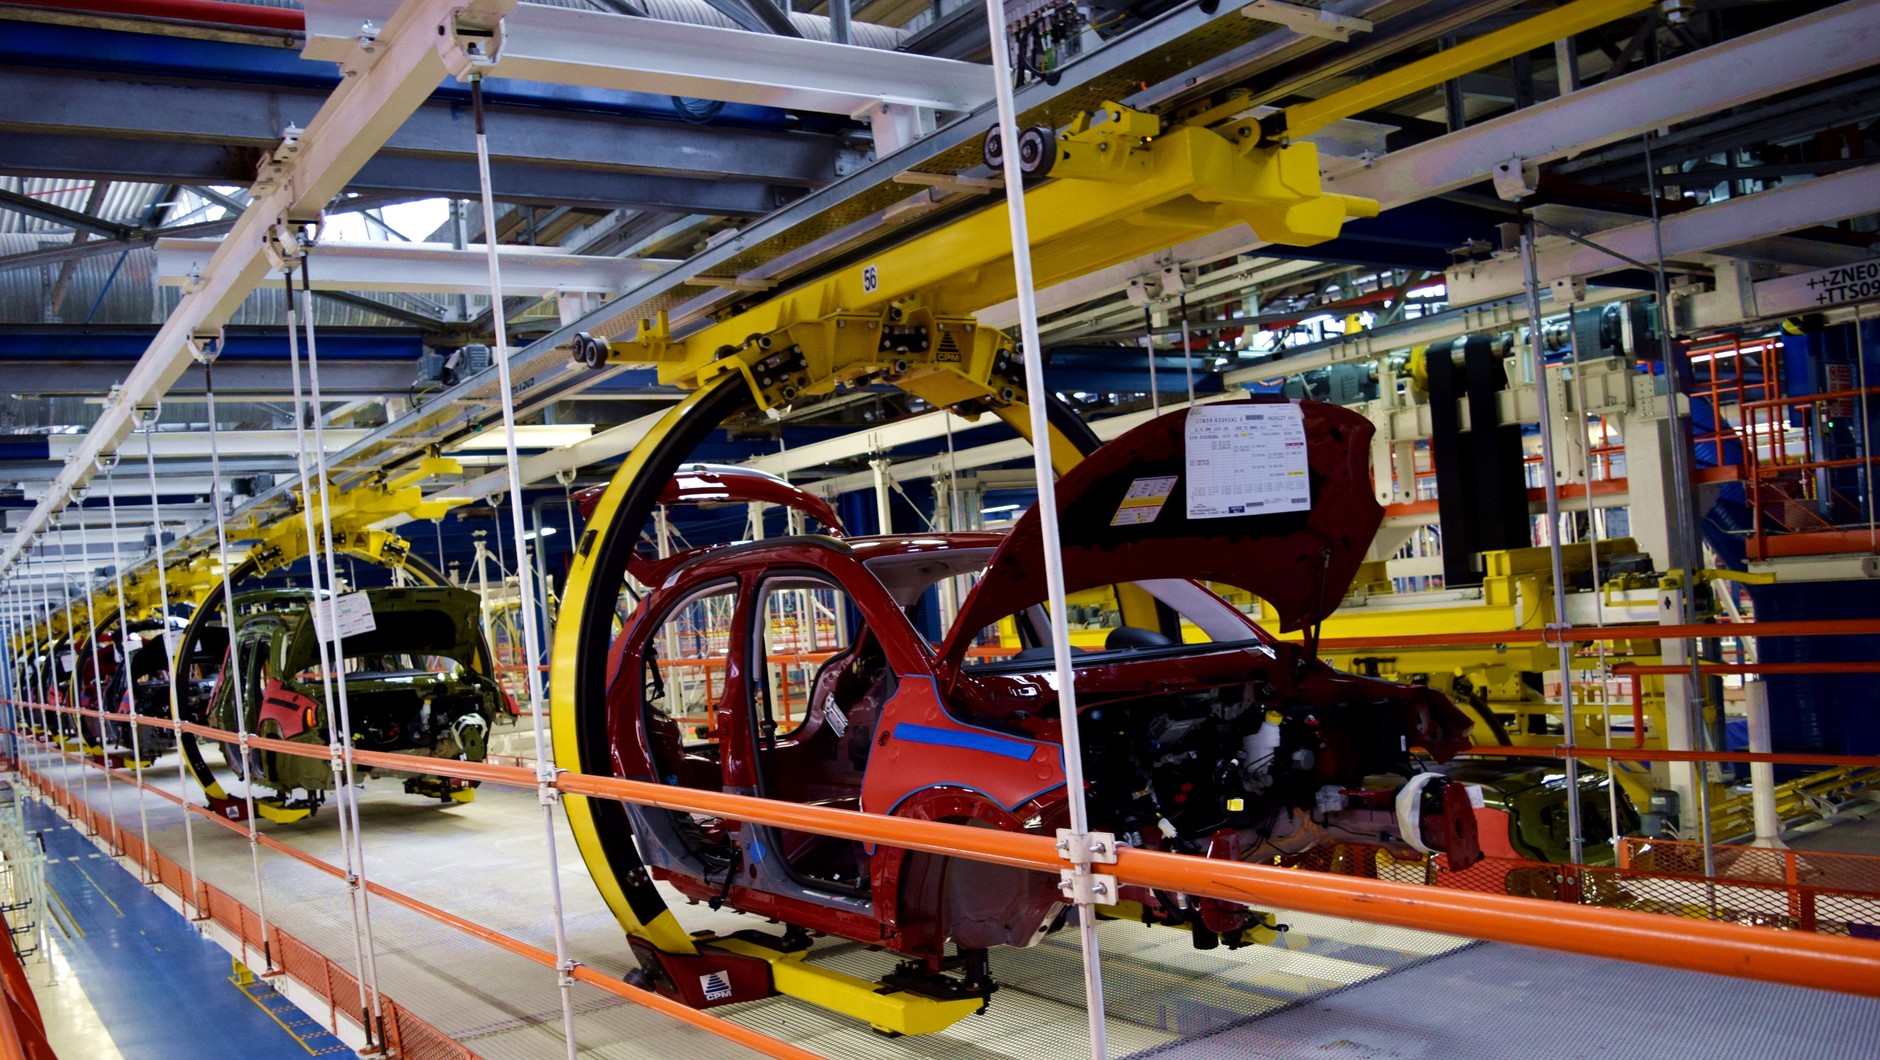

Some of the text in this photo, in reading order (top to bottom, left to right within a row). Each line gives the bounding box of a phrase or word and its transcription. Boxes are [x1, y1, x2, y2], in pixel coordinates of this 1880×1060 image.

[864, 267, 877, 291] 56
[937, 353, 961, 362] CPM
[706, 990, 732, 1001] CPM
